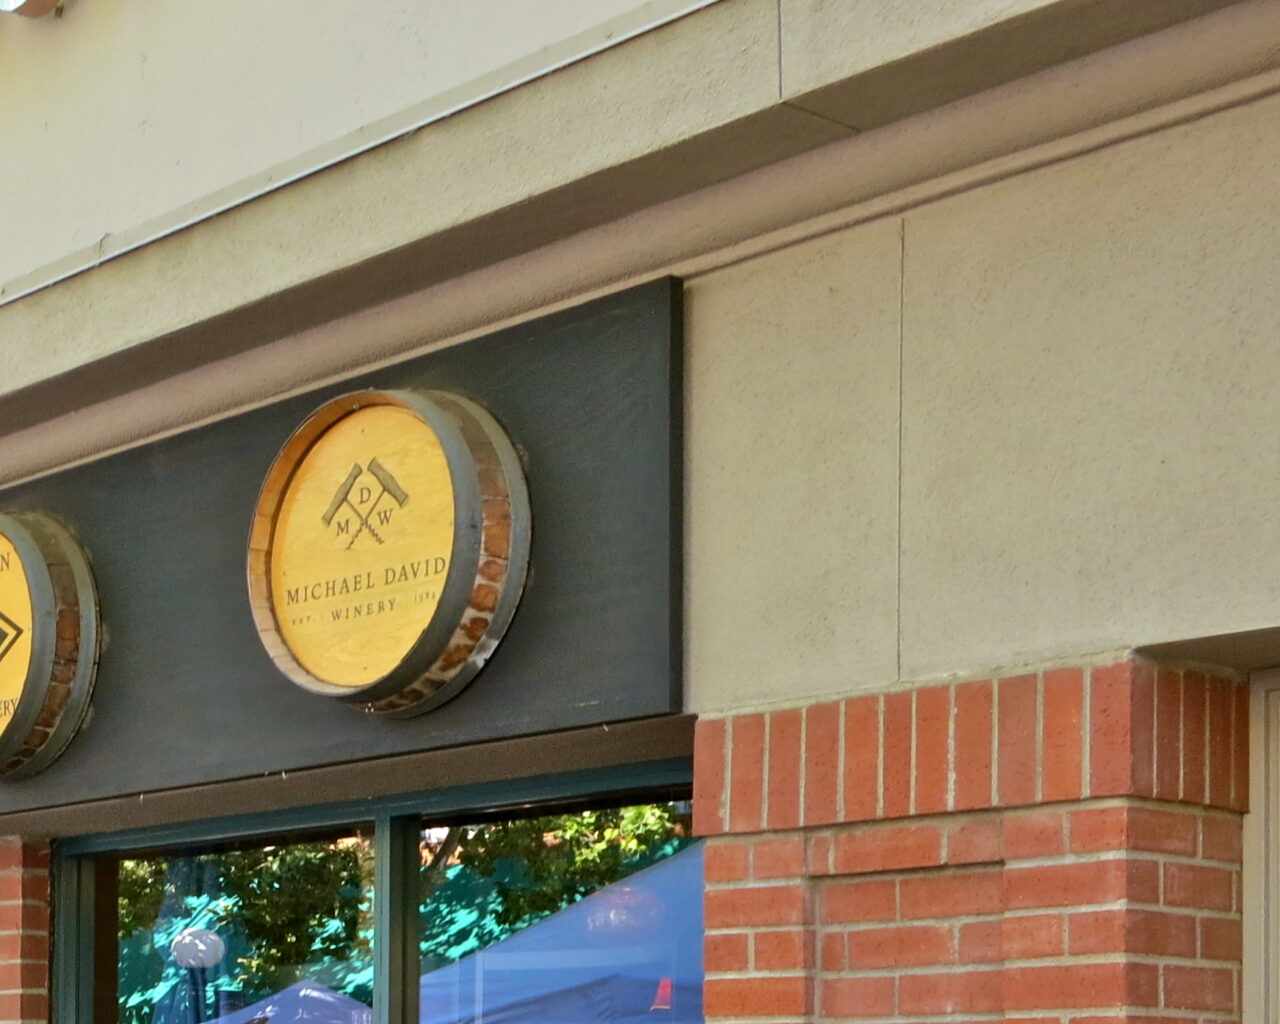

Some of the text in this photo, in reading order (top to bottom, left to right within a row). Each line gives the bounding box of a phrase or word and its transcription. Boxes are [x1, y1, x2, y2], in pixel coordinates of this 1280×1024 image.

[286, 556, 447, 606] MICHAEL DAVID
[331, 598, 397, 622] WINERY
